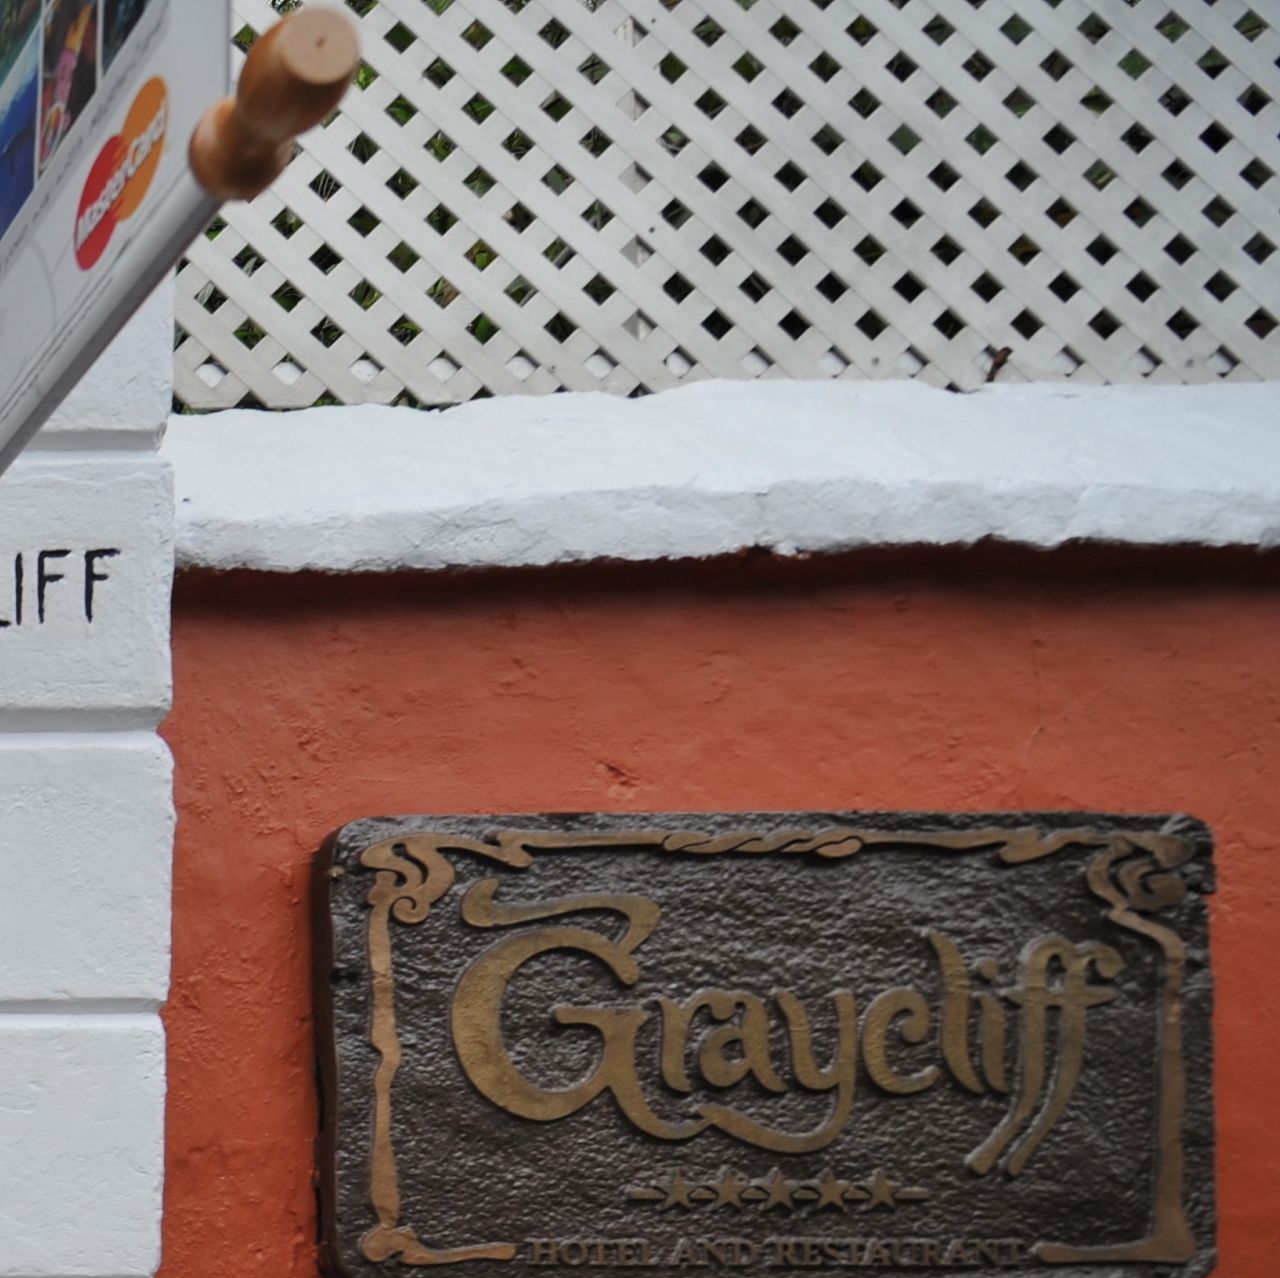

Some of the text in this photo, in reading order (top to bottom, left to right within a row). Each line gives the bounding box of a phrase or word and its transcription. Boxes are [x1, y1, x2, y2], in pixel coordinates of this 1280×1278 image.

[450, 878, 1126, 1175] Graycliff
[524, 1236, 1028, 1267] HOTEL AND RESTAURANT
